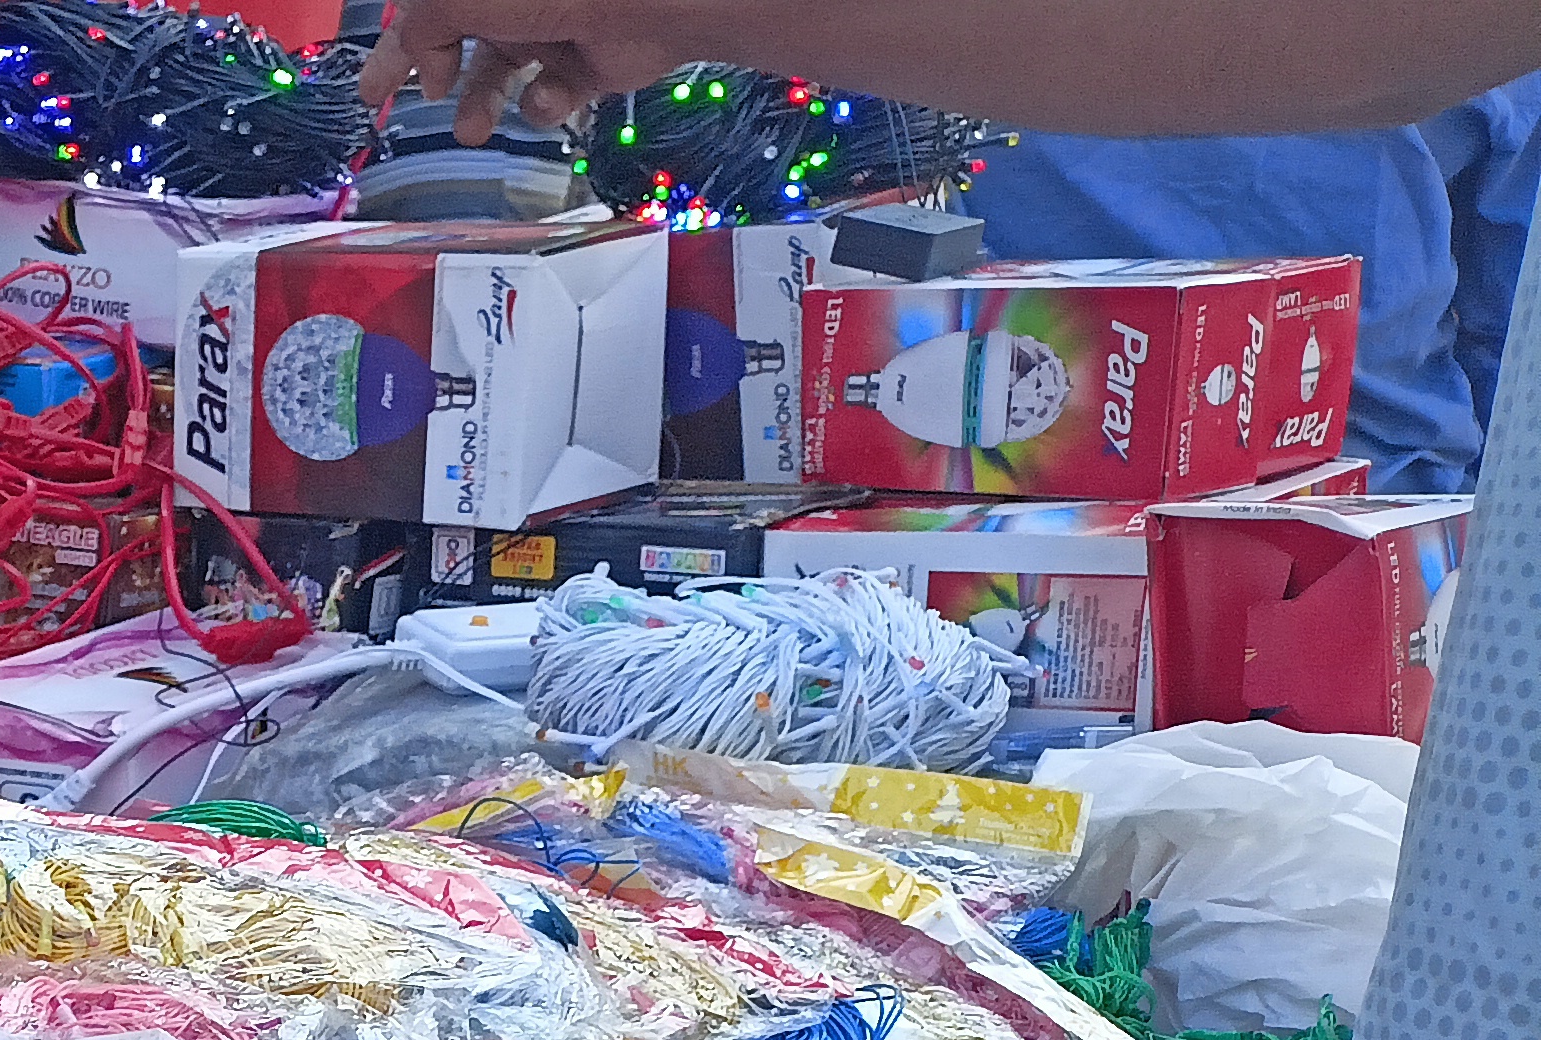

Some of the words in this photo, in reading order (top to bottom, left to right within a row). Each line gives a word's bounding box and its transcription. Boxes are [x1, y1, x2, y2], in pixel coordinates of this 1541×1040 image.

[91, 299, 131, 321] WIRE
[477, 266, 517, 345] Lamp
[824, 297, 844, 335] LED
[185, 291, 231, 474] Parax
[457, 420, 479, 514] DIAMOND
[773, 383, 795, 472] DIAMOND
